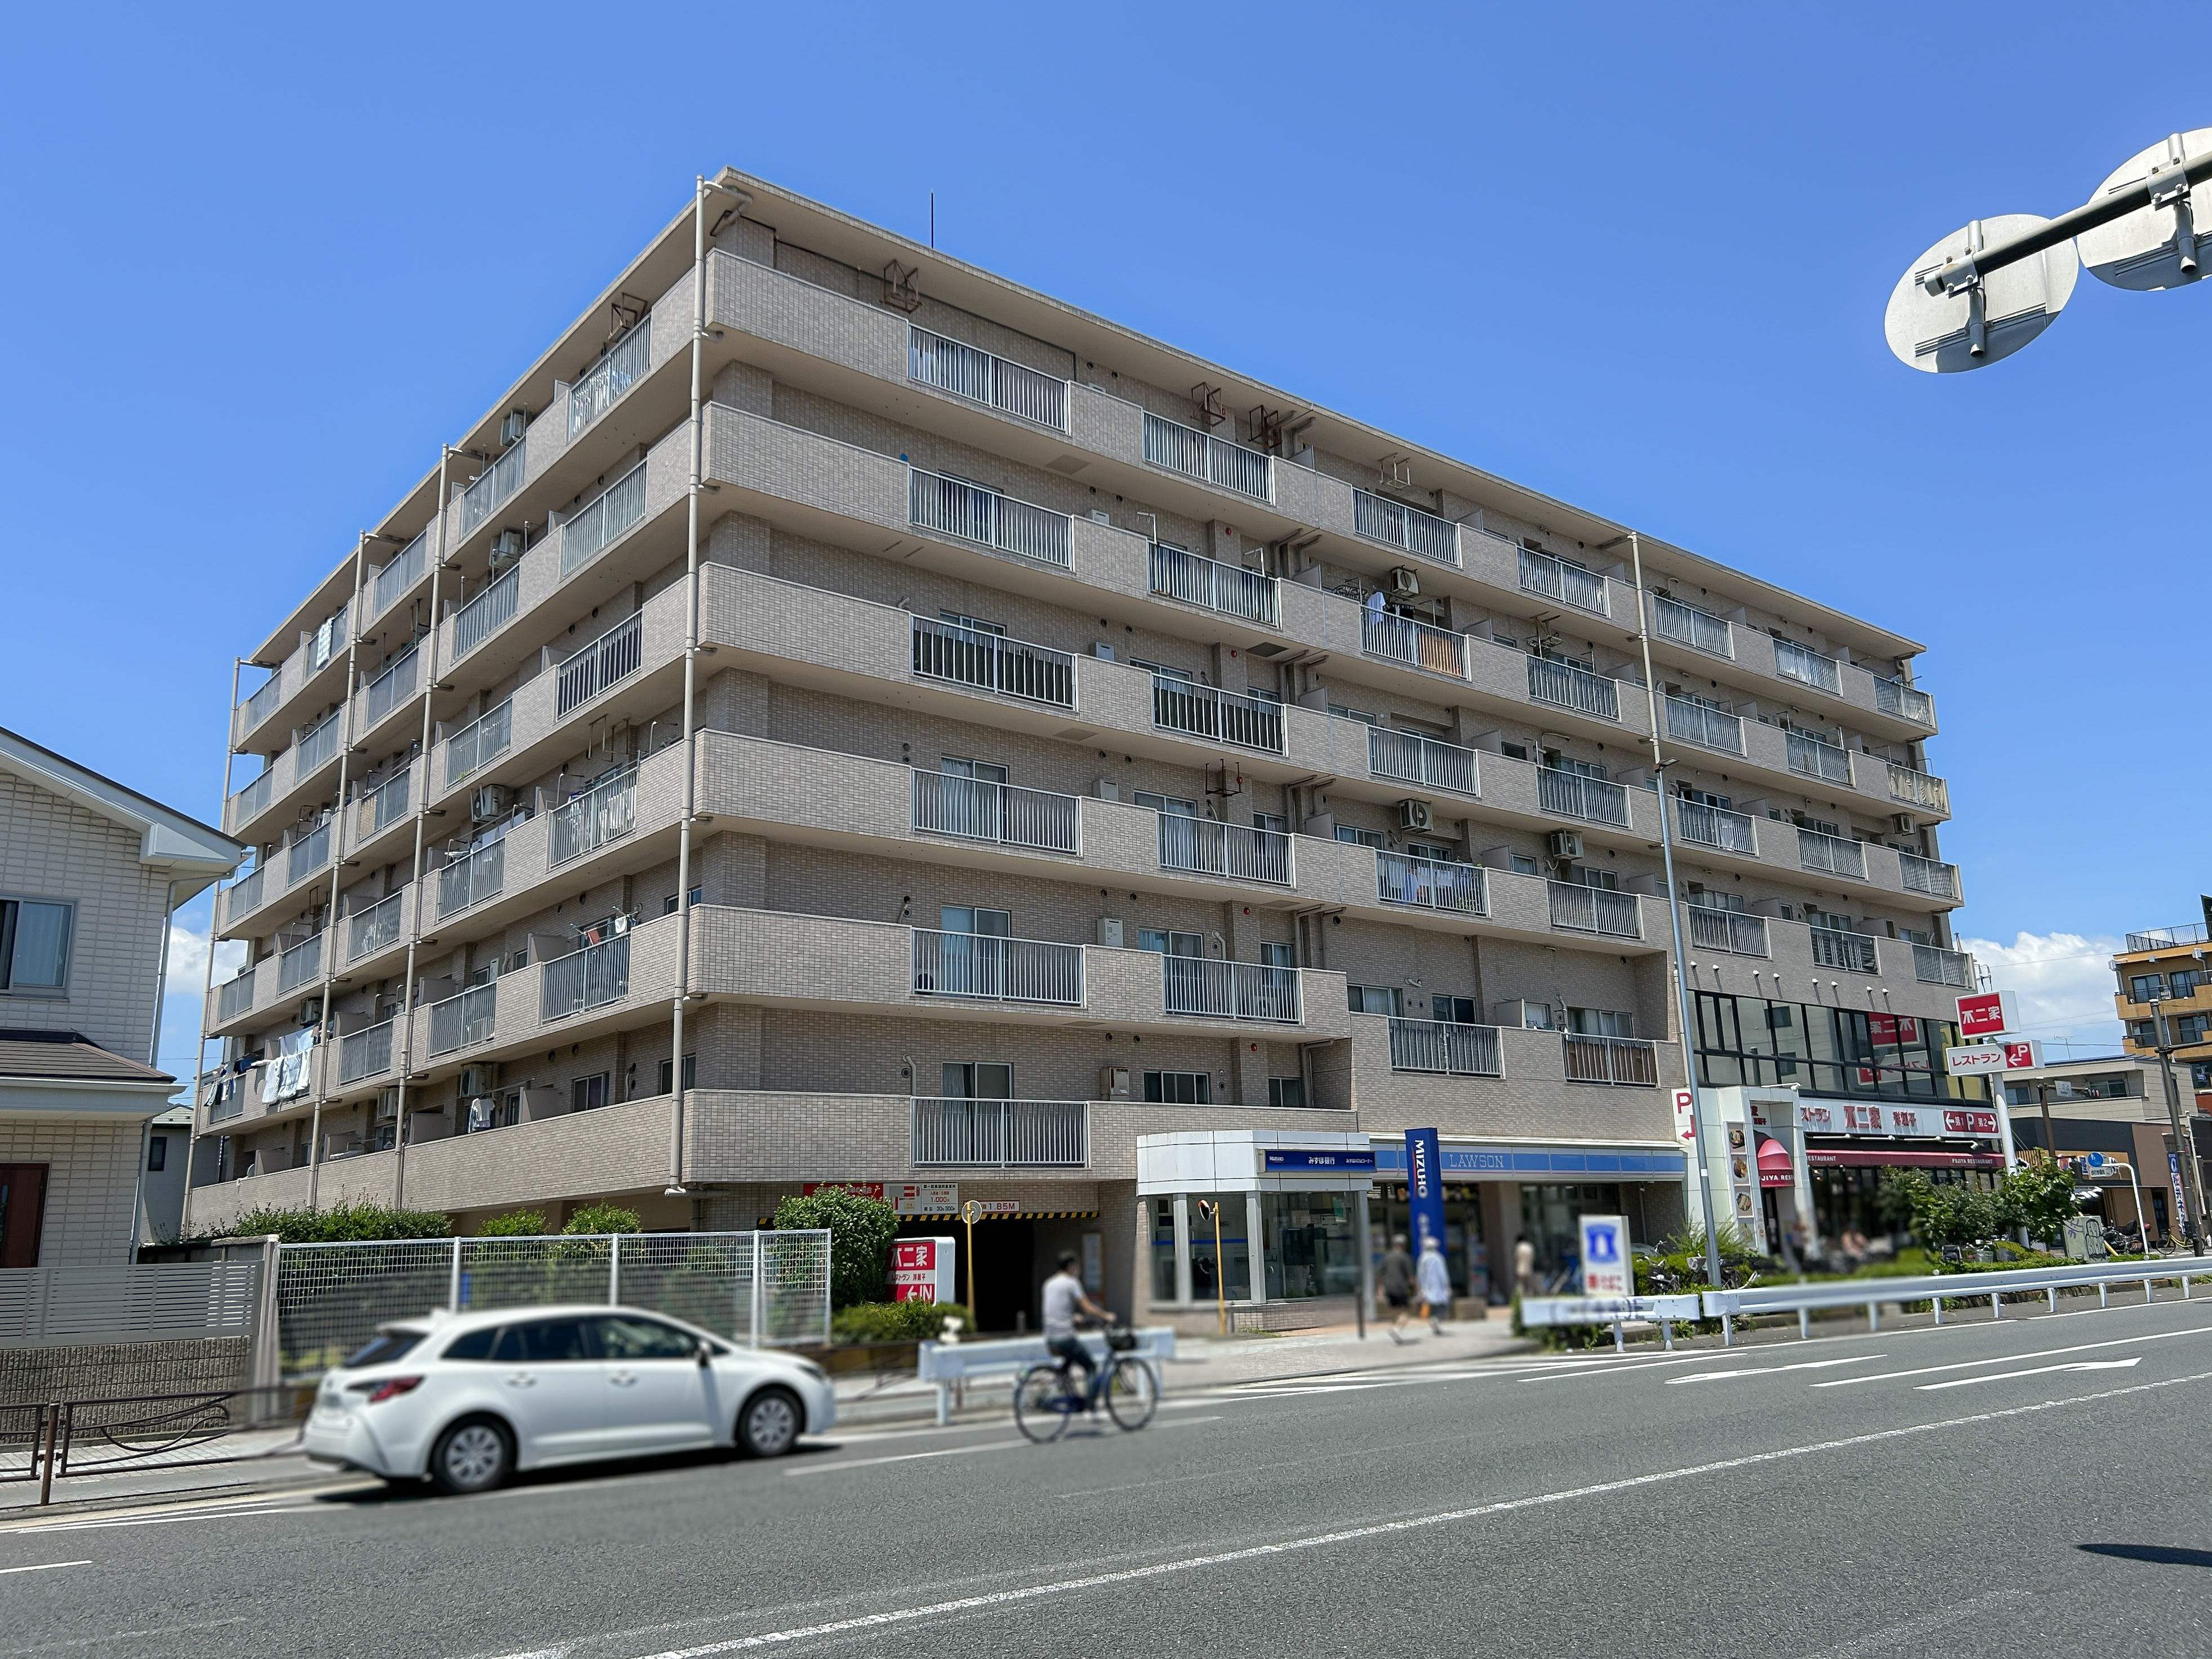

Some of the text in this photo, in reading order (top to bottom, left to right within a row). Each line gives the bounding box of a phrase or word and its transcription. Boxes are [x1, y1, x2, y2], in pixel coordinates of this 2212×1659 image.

[1961, 1006, 2001, 1024] 不二家
[1952, 1053, 2000, 1066] レストラン
[2017, 1045, 2028, 1057] P
[1676, 1093, 1692, 1114] P
[1844, 1105, 1882, 1129] 不二家
[1966, 1113, 1974, 1131] P
[1415, 1140, 1428, 1199] MIZUHO
[1449, 1154, 1504, 1168] LAWSON
[891, 1246, 928, 1267] 不二家
[919, 1285, 933, 1301] IN
